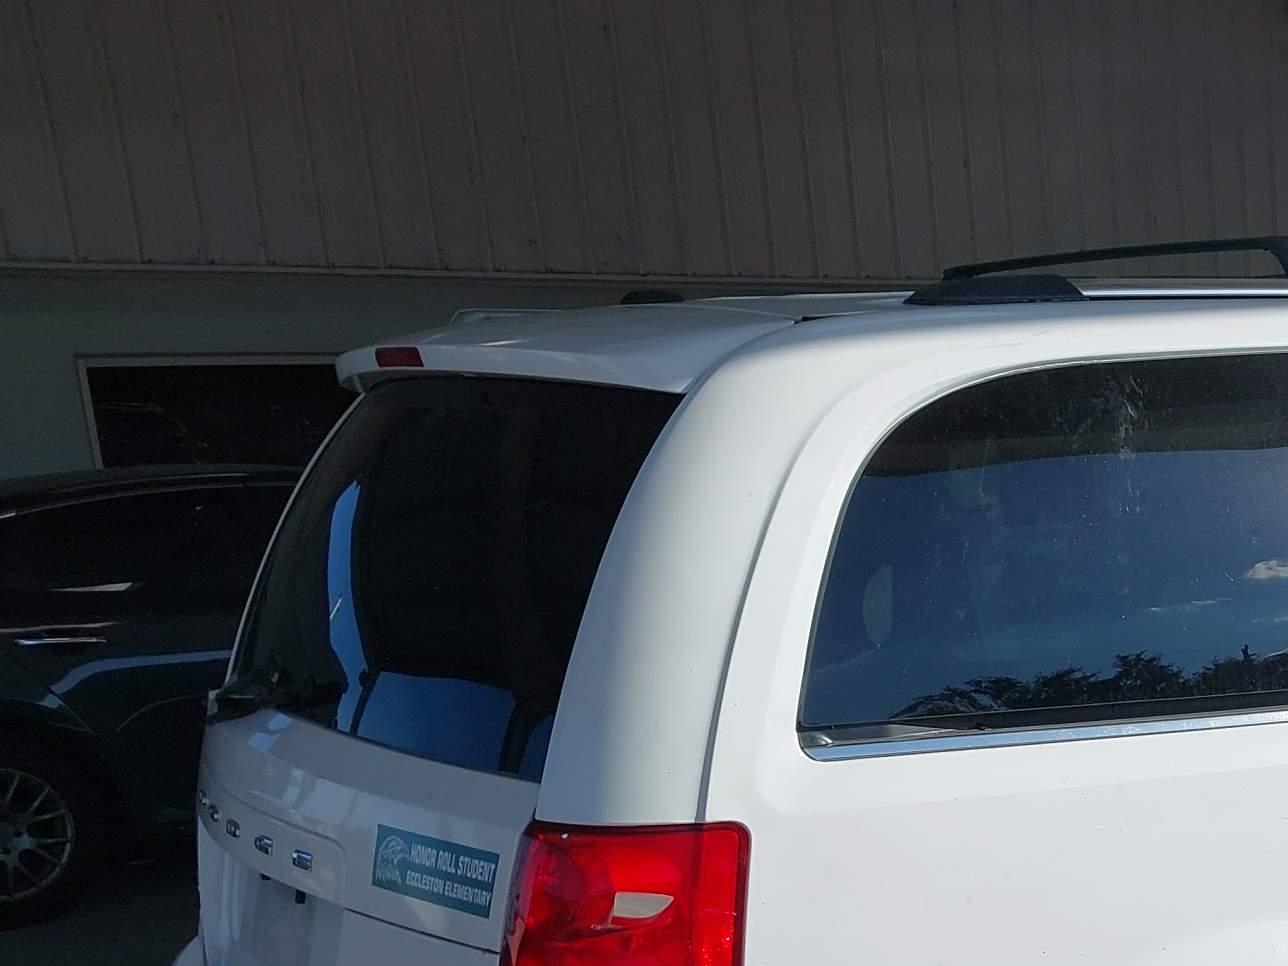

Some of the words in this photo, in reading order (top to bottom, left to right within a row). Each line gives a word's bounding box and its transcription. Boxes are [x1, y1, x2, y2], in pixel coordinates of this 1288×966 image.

[410, 841, 437, 868] HONOR
[437, 849, 457, 875] ROLL
[456, 855, 496, 883] STUDENT
[404, 869, 445, 896] ECCLESTON
[444, 880, 492, 907] ELEMENTARY
